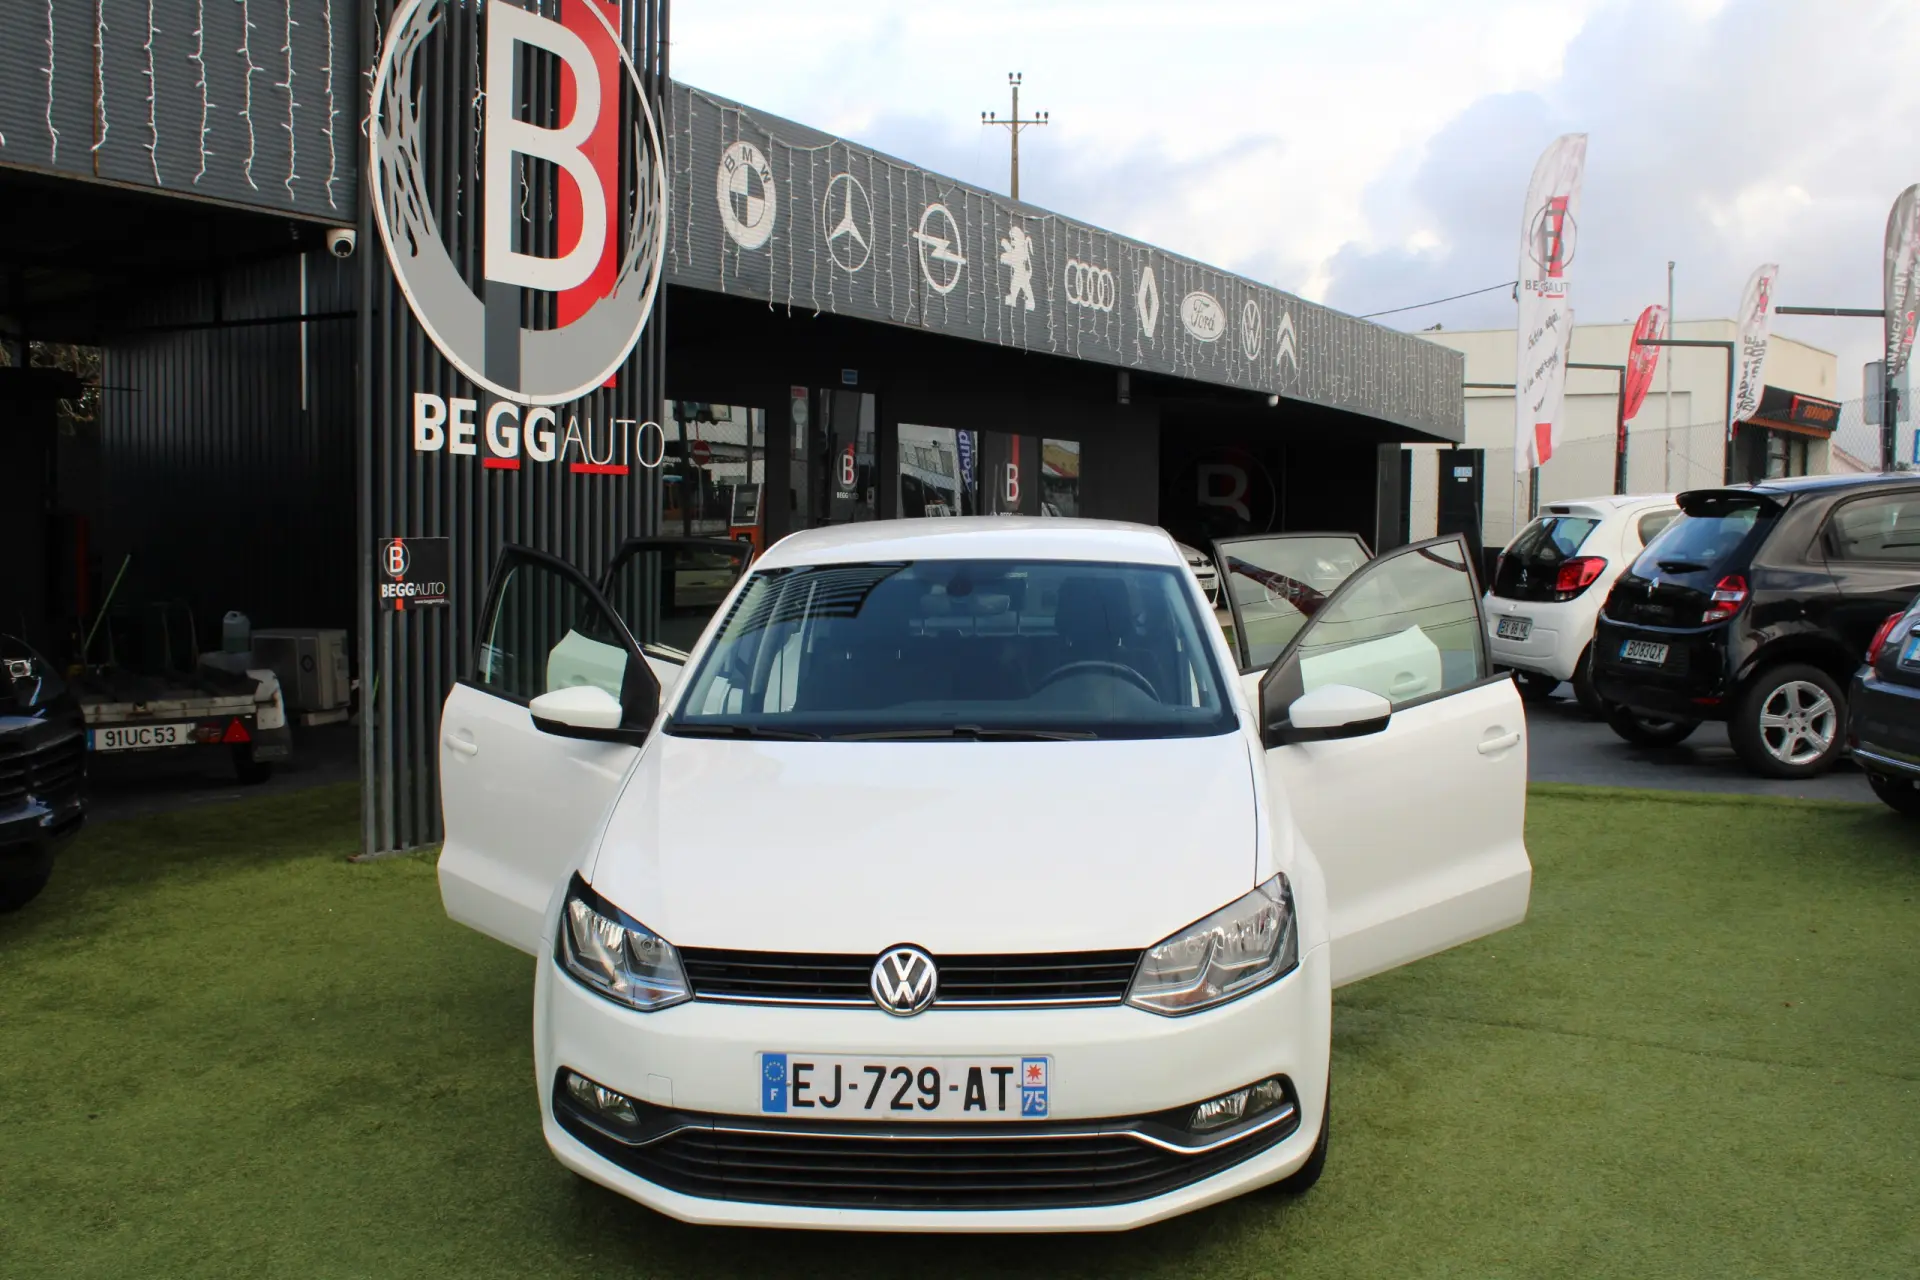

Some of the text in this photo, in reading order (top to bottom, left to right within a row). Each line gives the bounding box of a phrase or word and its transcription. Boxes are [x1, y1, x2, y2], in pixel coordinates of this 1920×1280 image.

[484, 0, 607, 291] B
[723, 145, 771, 184] BMW
[1190, 298, 1216, 332] Ford
[414, 392, 665, 468] BEGGAUTO
[388, 546, 405, 574] B
[381, 580, 445, 598] BEGGAUTO
[769, 1087, 779, 1101] F
[792, 1062, 1014, 1112] EJ-729-AT
[1023, 1090, 1046, 1112] 75
